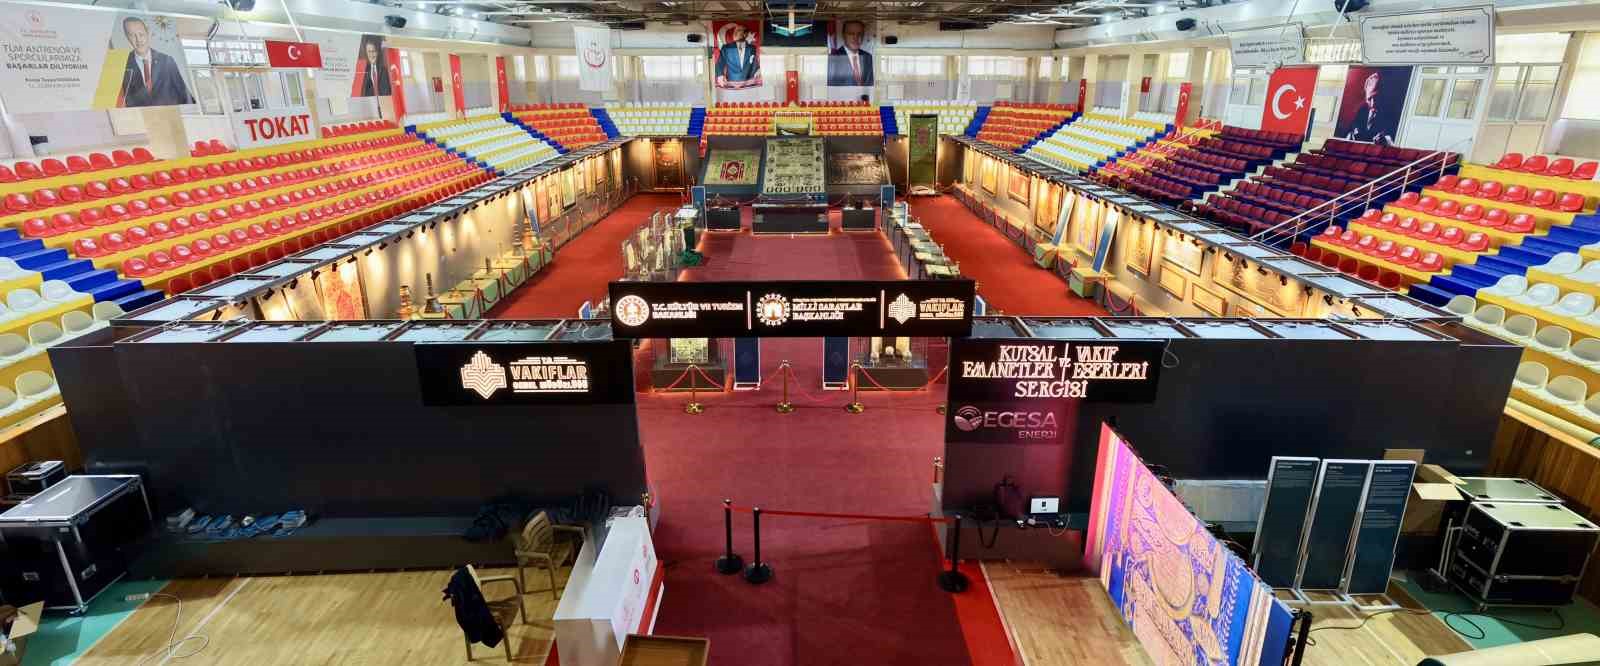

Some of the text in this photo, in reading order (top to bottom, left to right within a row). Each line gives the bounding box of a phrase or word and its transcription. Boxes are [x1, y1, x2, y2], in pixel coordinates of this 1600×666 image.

[244, 114, 310, 142] TOKAT
[998, 345, 1120, 363] KUTSAL VAKIF
[510, 365, 587, 380] VAKIFLAR
[962, 361, 1150, 380] EMANETLER ESERLERİ
[1015, 380, 1088, 398] SERGİSİ
[983, 411, 1058, 428] EGESA
